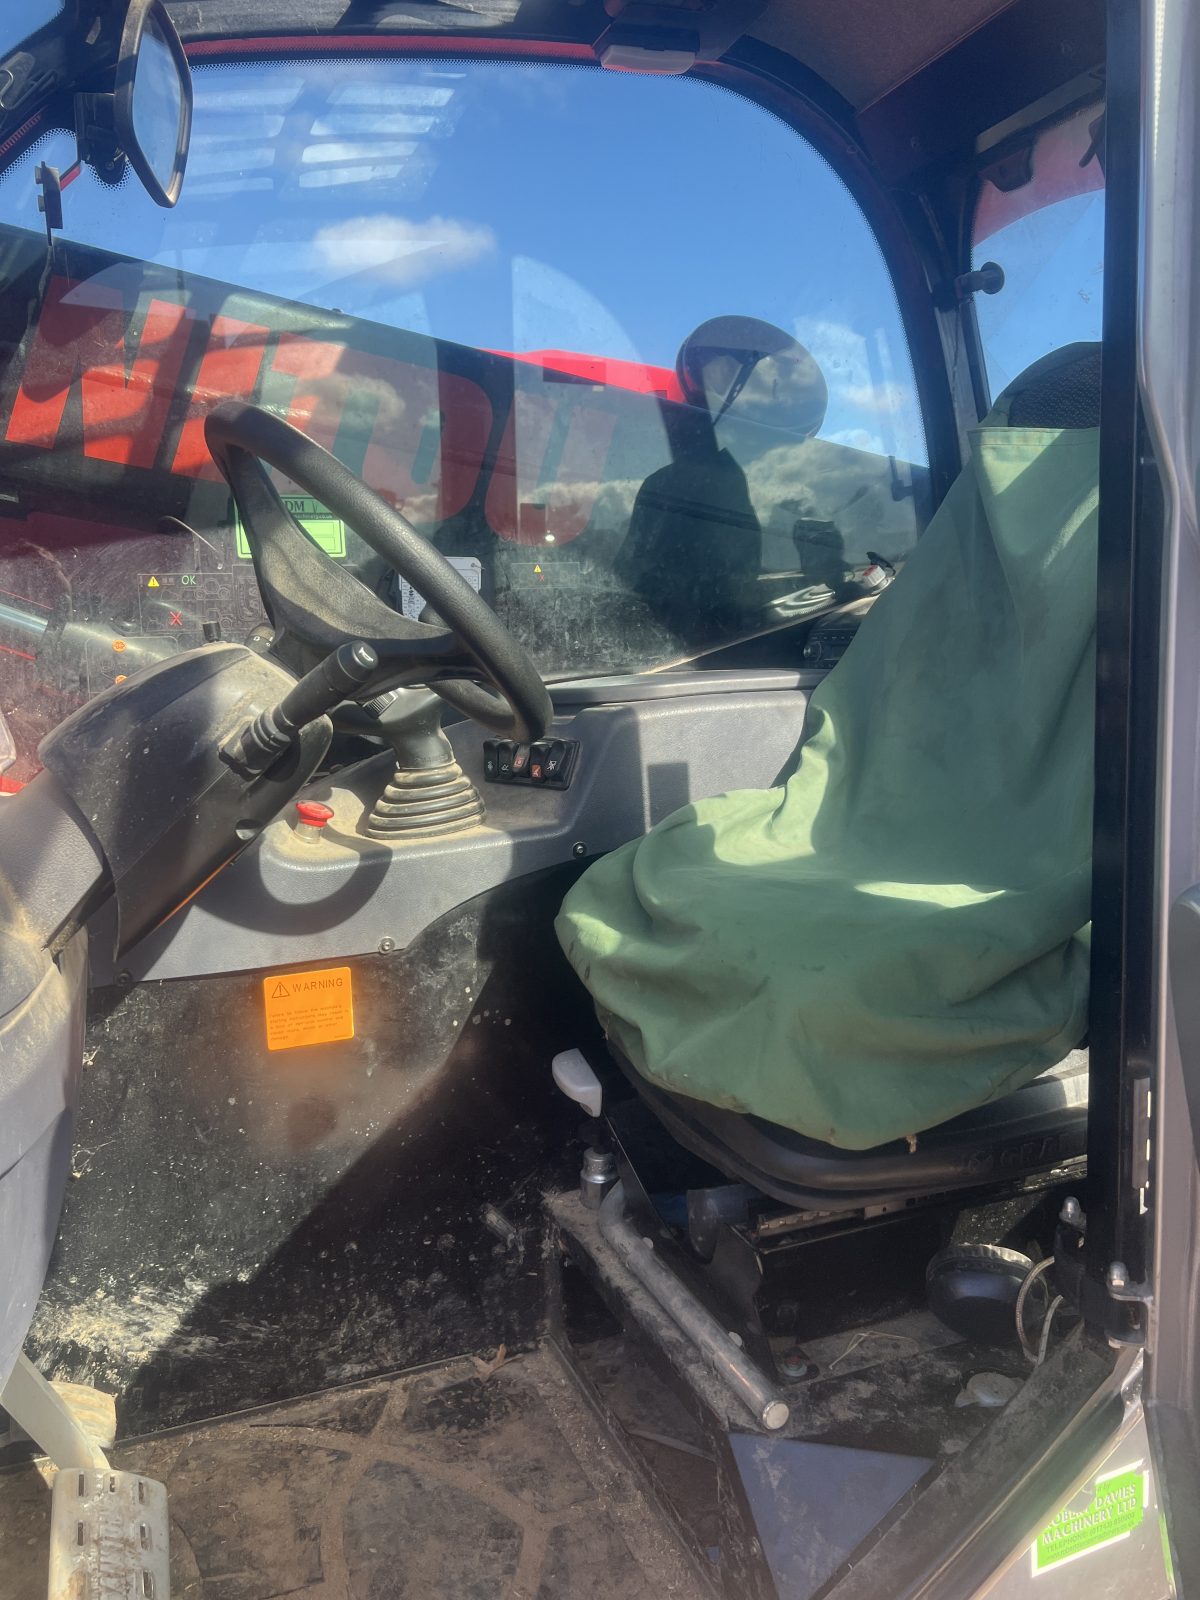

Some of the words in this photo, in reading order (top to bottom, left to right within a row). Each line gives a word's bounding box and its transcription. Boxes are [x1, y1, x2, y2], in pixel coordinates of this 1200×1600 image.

[181, 575, 197, 585] OK
[292, 977, 343, 993] WARNING
[1095, 1483, 1136, 1510] DAVIES
[1042, 1506, 1114, 1546] MACHINERY
[1117, 1498, 1137, 1515] LTD
